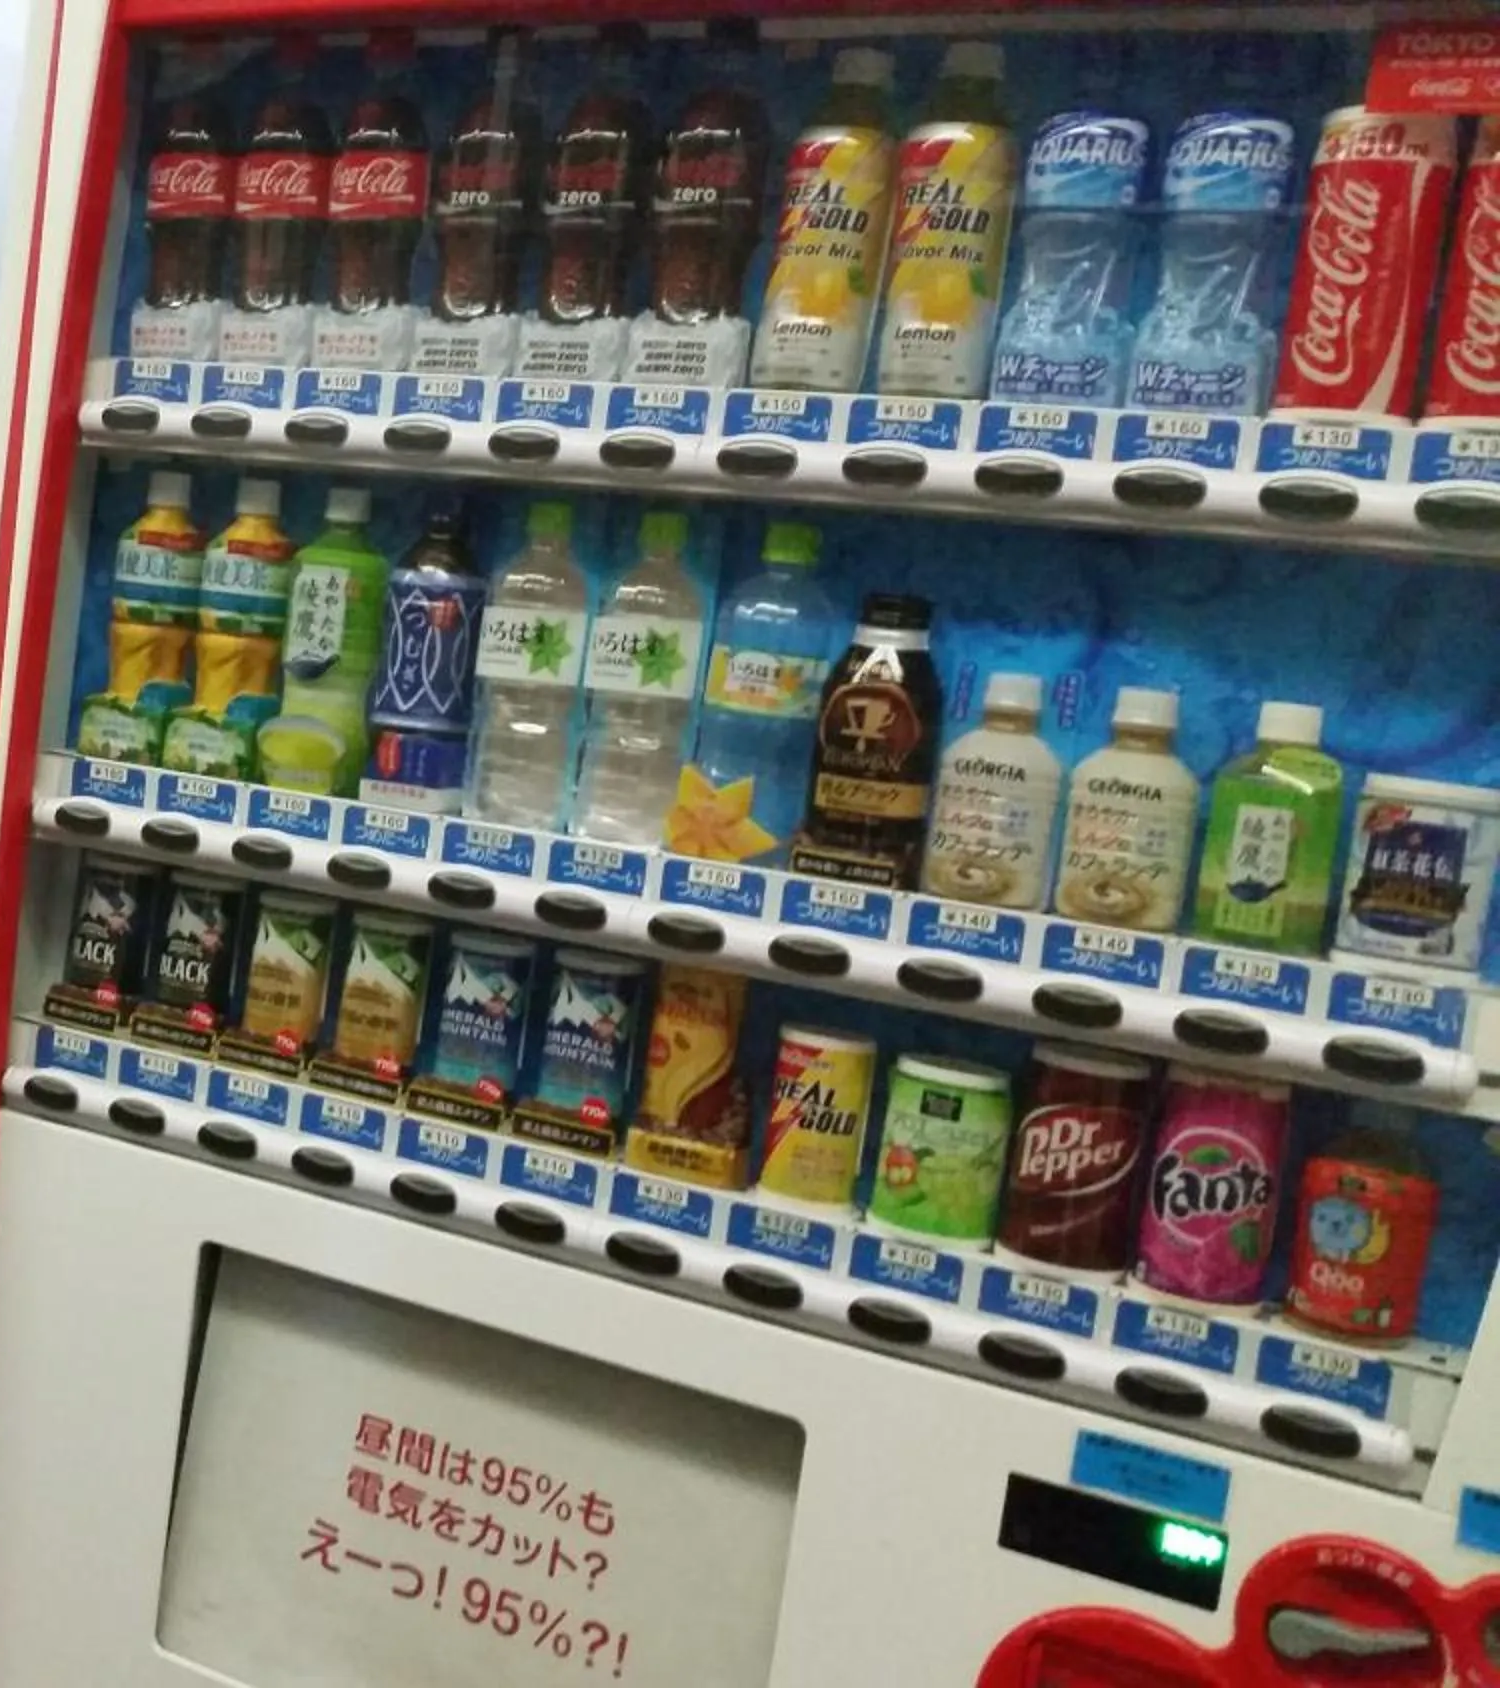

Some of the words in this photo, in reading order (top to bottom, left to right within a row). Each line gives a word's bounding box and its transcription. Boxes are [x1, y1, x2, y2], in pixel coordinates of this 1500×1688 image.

[451, 191, 490, 206] zero
[560, 190, 601, 206] zero
[673, 187, 718, 202] zero
[787, 180, 846, 206] REAL
[904, 178, 965, 205] REAL
[810, 206, 869, 234] GOLD
[929, 206, 990, 234] GOLD
[828, 243, 863, 261] Mix
[949, 245, 984, 263] Mix
[772, 318, 832, 337] Lemon
[895, 324, 956, 343] Lemon
[999, 353, 1108, 377] Wチャージ
[1137, 363, 1246, 391] Wチャージ
[953, 758, 1027, 783] GEORGIA
[1087, 777, 1164, 802] GEORGIA
[774, 1078, 836, 1107] REAL
[799, 1110, 858, 1136] GOLD
[1050, 1117, 1101, 1147] Dr
[1018, 1125, 1125, 1183] Pepper
[1308, 1261, 1365, 1296] Qoo
[354, 1412, 616, 1538] 昼間は95%も
[345, 1465, 610, 1592] 電気をカット?
